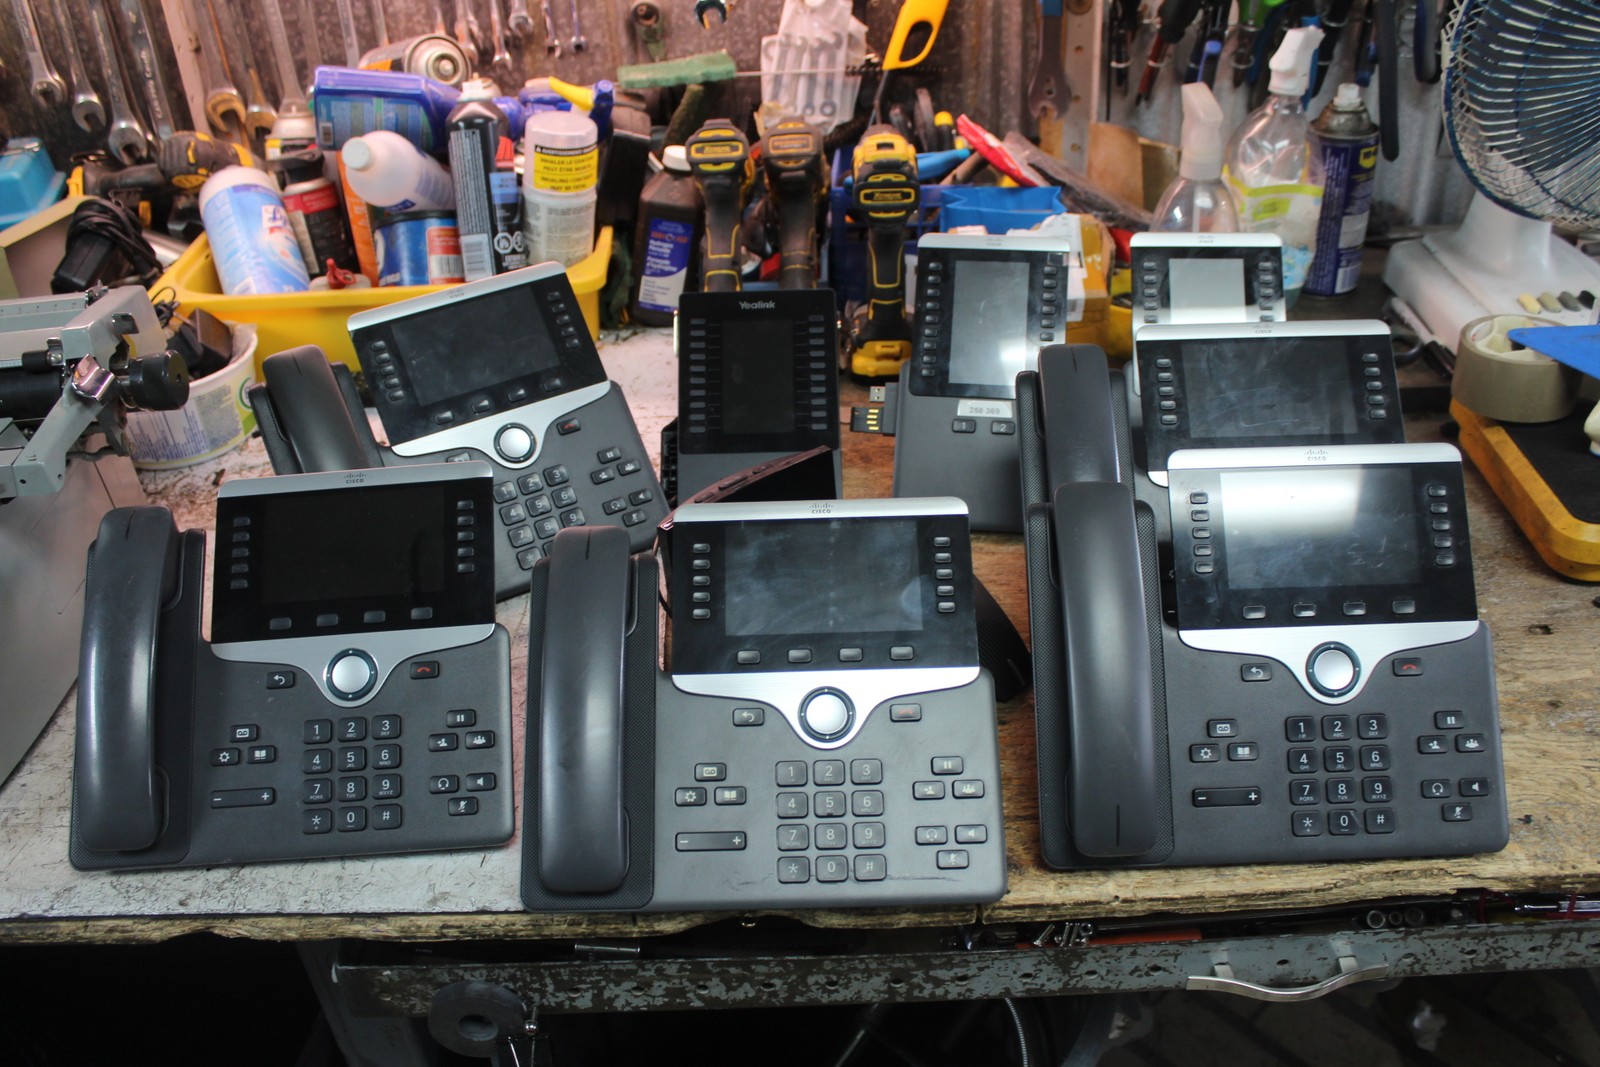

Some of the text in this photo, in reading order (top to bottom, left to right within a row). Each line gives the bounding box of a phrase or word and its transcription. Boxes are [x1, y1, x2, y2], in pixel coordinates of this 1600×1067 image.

[739, 300, 776, 309] Yealink
[1000, 424, 1006, 432] 2
[552, 470, 560, 478] 3
[569, 513, 577, 521] 9
[544, 522, 551, 530] 8
[518, 530, 524, 538] 7
[314, 725, 319, 735] 1
[348, 722, 355, 732] 2
[382, 720, 390, 731] 3
[1299, 722, 1304, 733] 1
[1334, 721, 1342, 732] 2
[1369, 720, 1377, 731] 3
[313, 755, 320, 764] 4
[347, 752, 354, 762] 5
[381, 750, 389, 760] 6
[1300, 753, 1308, 764] 4
[1336, 752, 1344, 763] 5
[1372, 751, 1380, 762] 6
[789, 767, 793, 776] 1
[826, 766, 833, 776] 2
[863, 764, 871, 775] 3
[313, 784, 320, 794] 7
[347, 782, 355, 793] 8
[382, 780, 390, 790] 9
[1302, 785, 1310, 795] 7
[1338, 783, 1346, 794] 8
[1374, 783, 1382, 794] 9
[788, 798, 796, 808] 4
[826, 797, 834, 807] 5
[863, 796, 871, 807] 6
[347, 812, 354, 822] 0
[1340, 815, 1349, 826] 0
[789, 830, 797, 840] 7
[826, 829, 835, 840] 8
[865, 828, 873, 839] 9
[827, 861, 836, 872] 0
